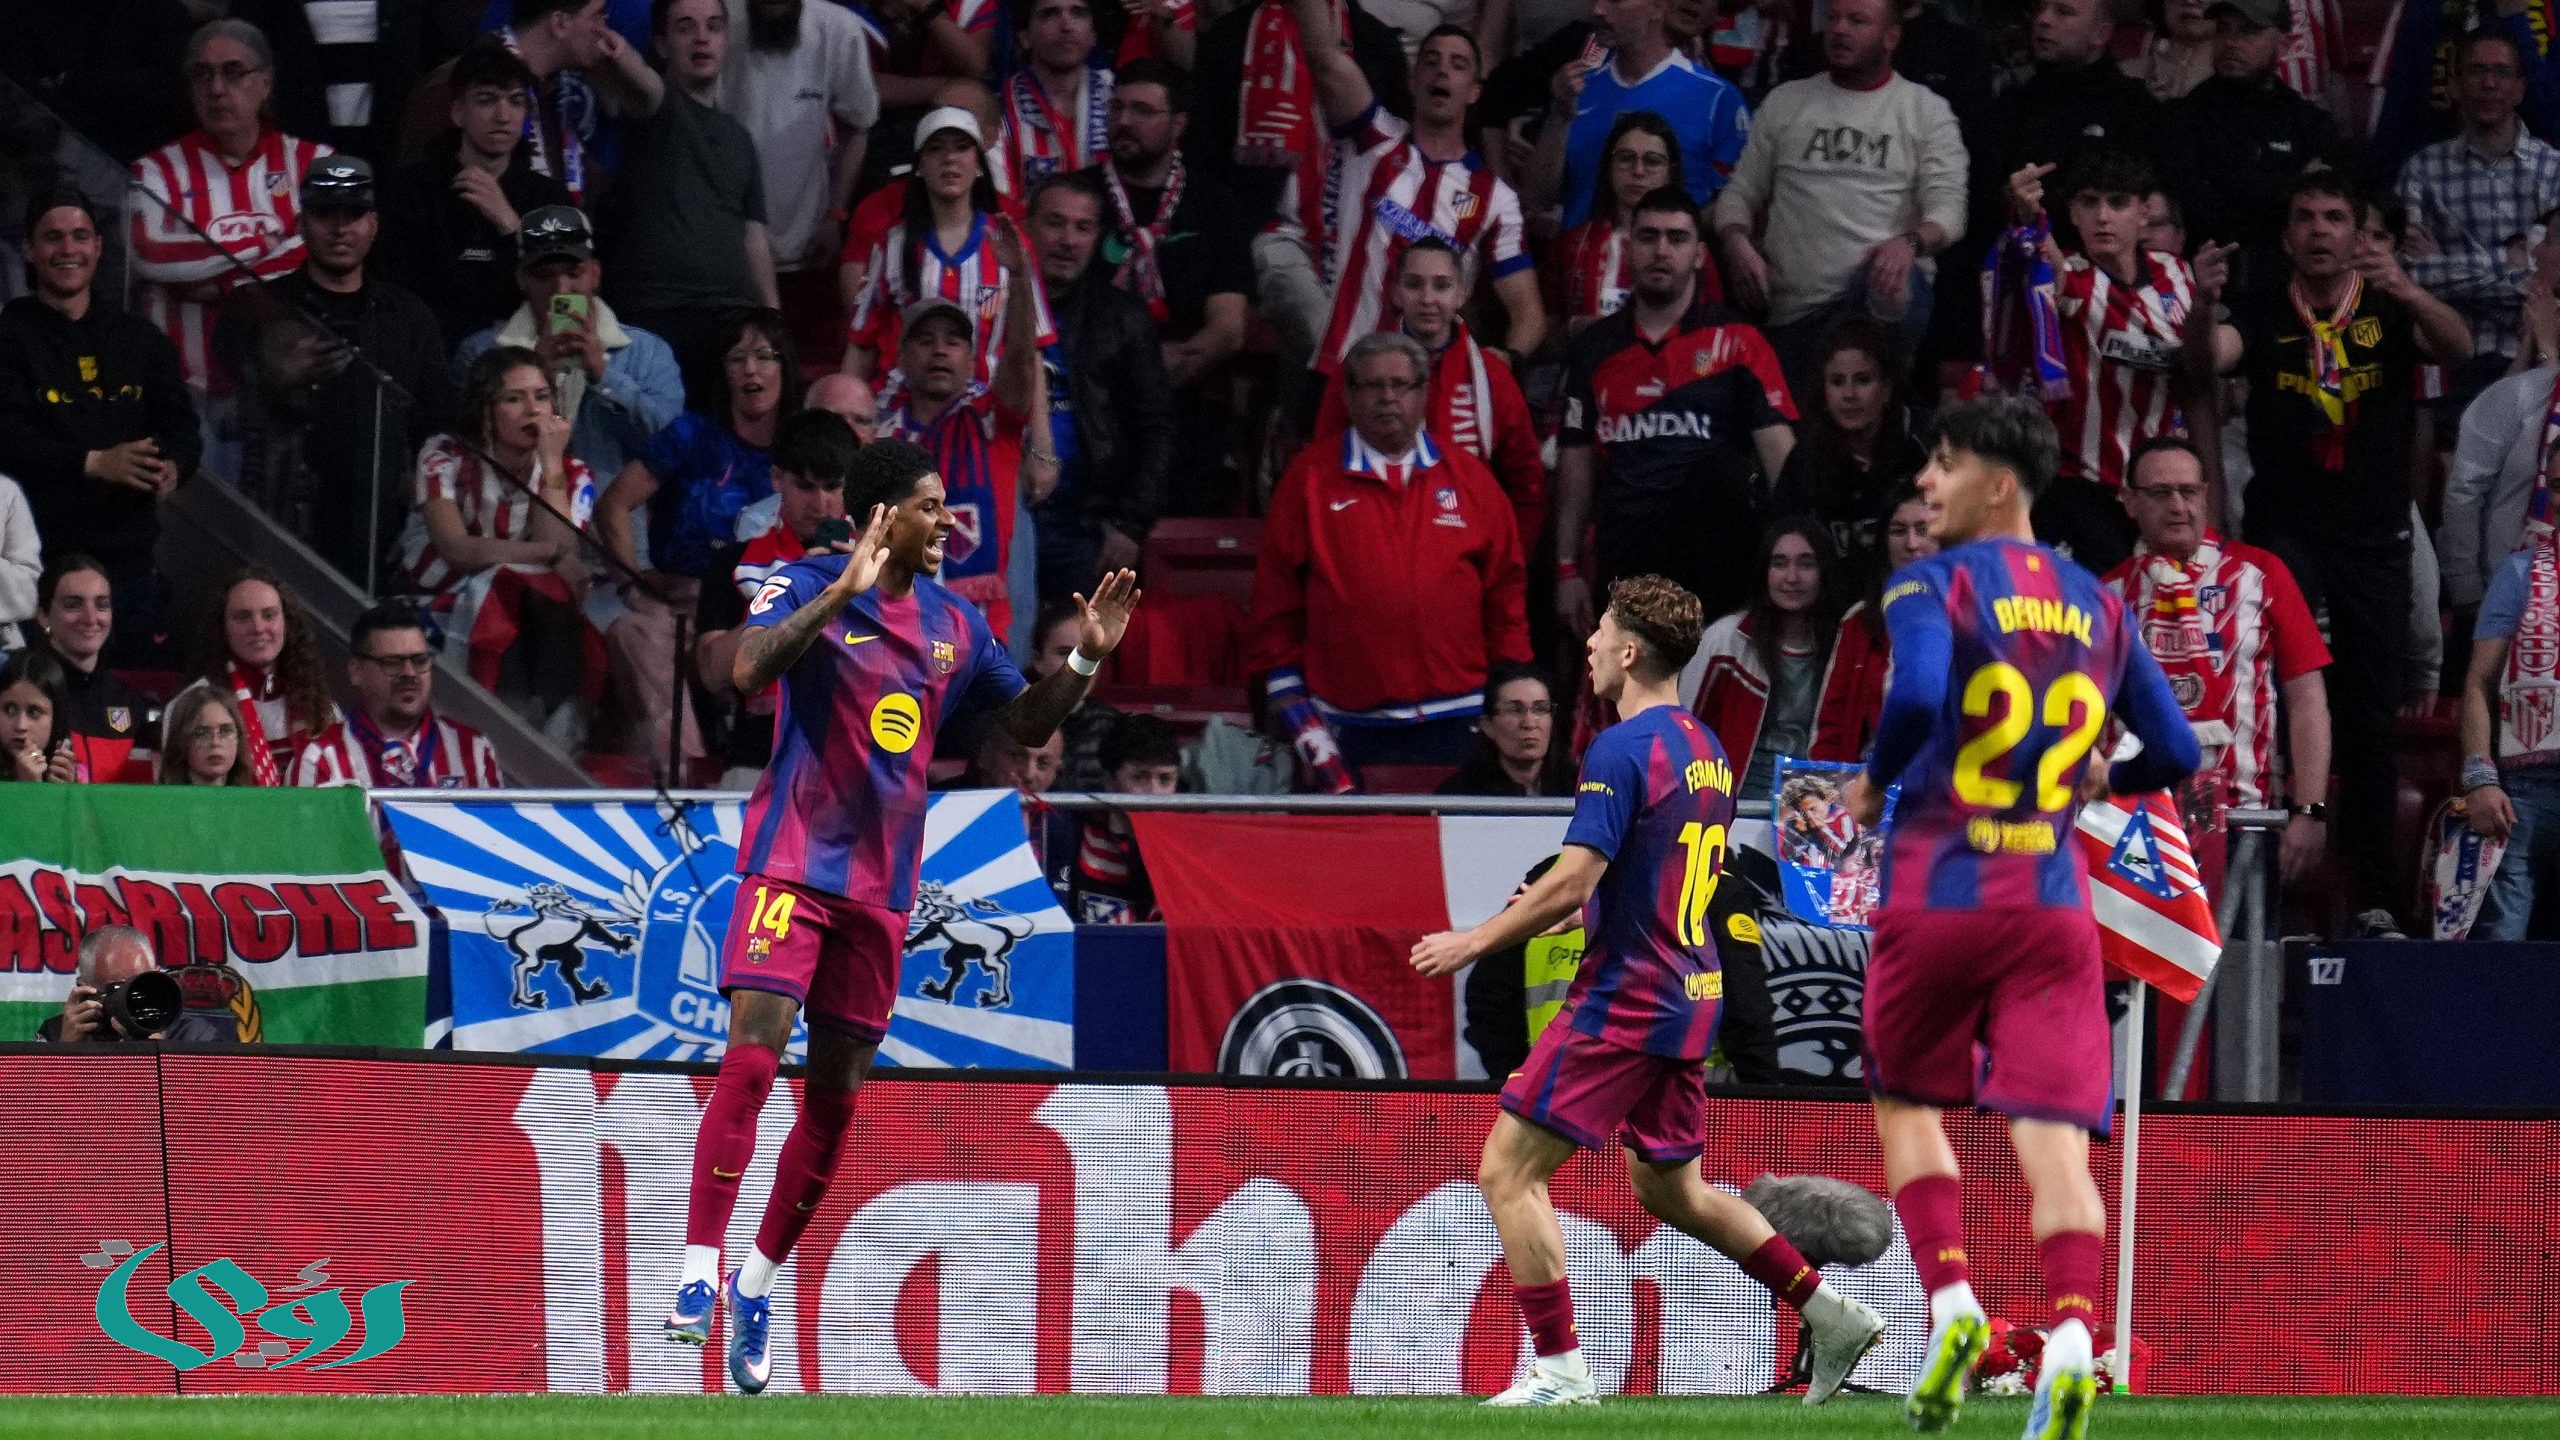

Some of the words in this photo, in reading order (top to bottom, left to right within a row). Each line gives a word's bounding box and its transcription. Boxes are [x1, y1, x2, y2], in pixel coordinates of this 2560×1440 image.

[1993, 596, 2093, 648] BERNAL
[1953, 661, 2106, 812] 22
[1685, 758, 1733, 797] FERMÍN
[1677, 821, 1726, 946] 16
[748, 886, 797, 940] 14
[2308, 957, 2347, 985] 127
